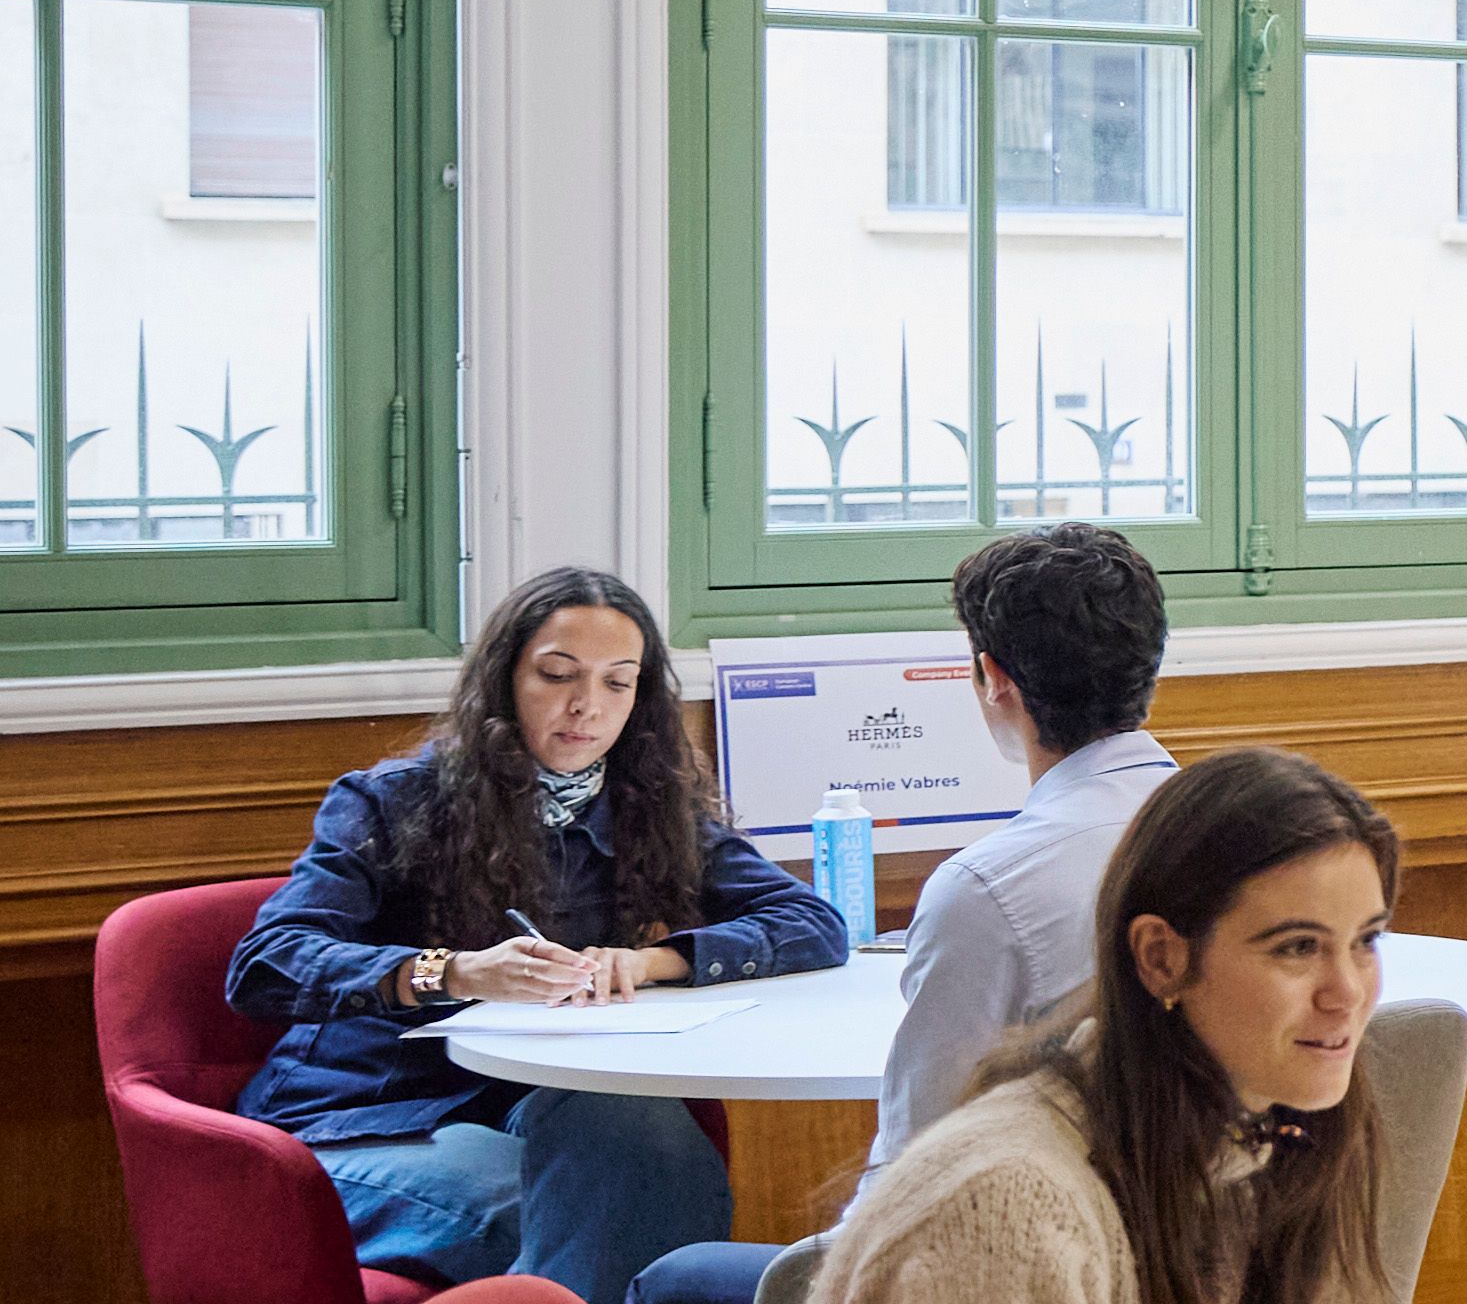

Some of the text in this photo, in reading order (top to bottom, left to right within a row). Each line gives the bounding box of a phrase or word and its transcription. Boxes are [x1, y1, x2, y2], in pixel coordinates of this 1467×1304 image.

[847, 725, 924, 742] HERMÈS
[870, 741, 902, 751] PARIS
[901, 775, 961, 790] Vabres
